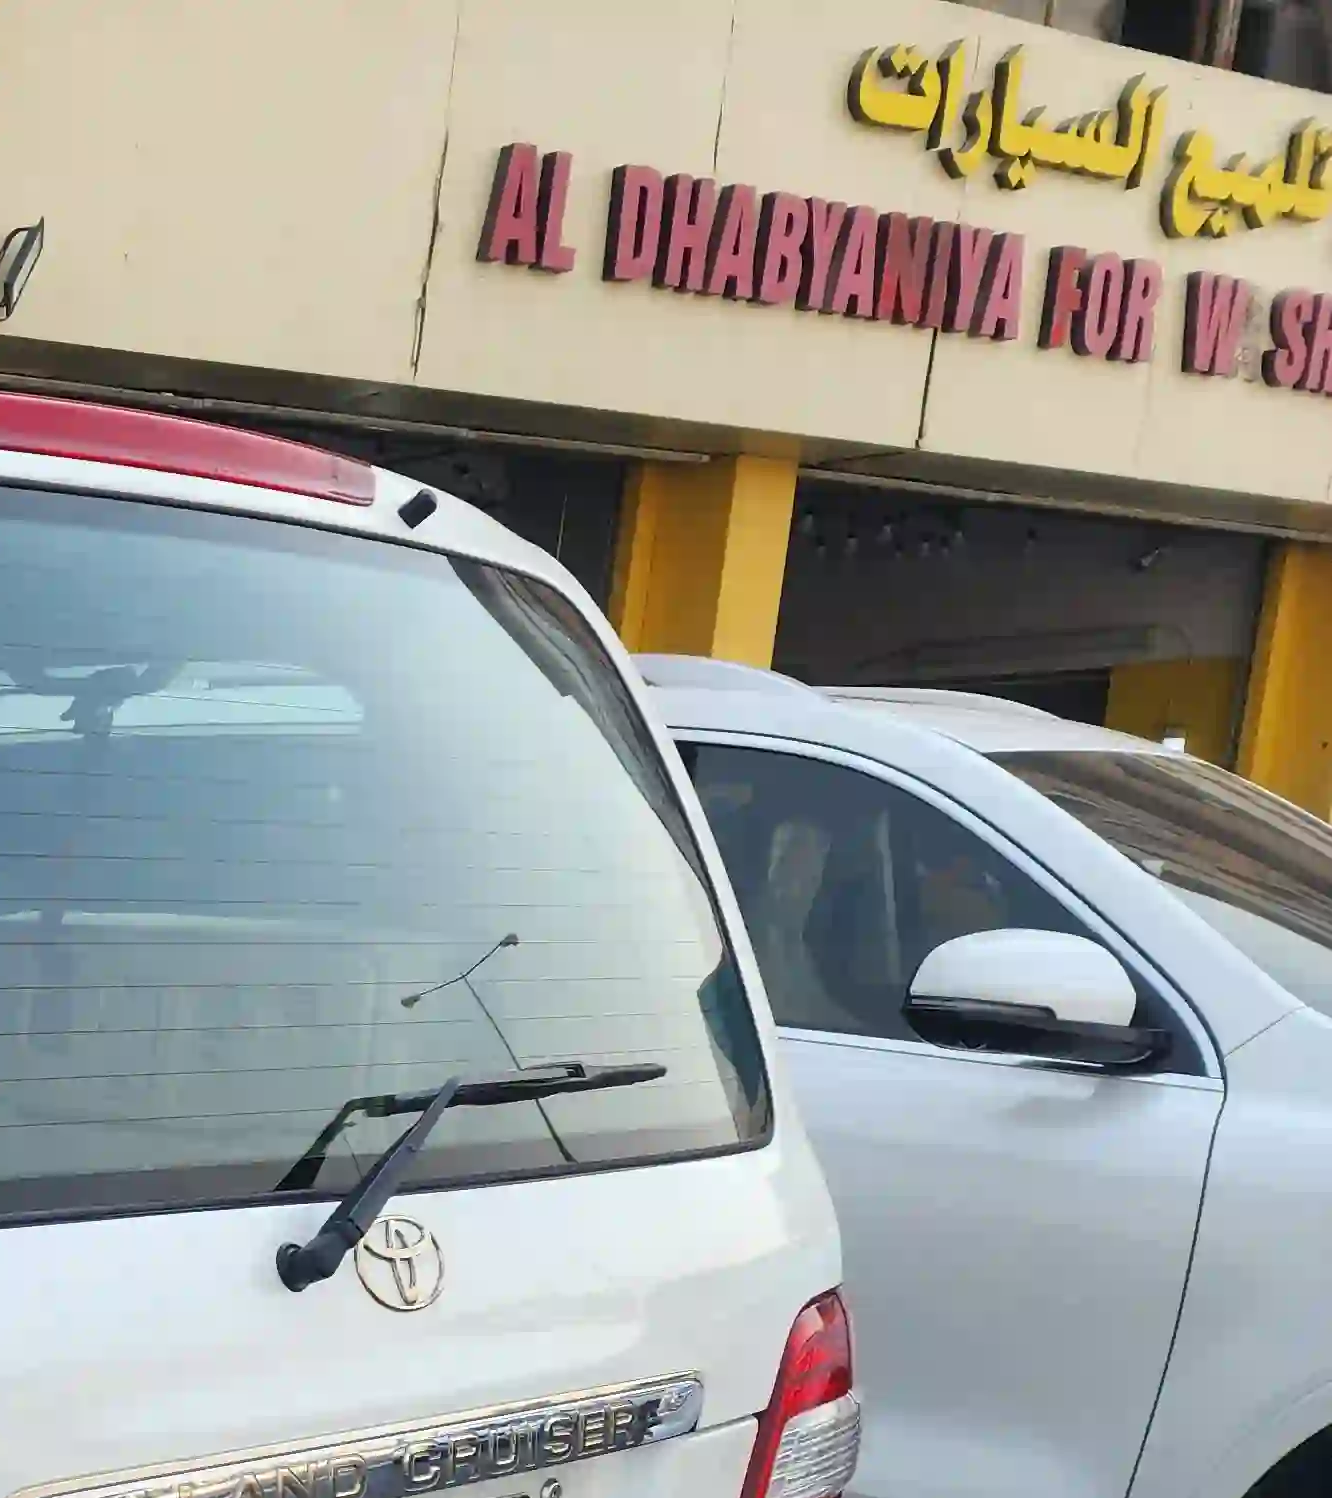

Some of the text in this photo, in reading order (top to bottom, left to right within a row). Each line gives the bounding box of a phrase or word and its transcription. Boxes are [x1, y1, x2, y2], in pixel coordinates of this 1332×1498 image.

[847, 38, 1169, 191] السيارات
[476, 142, 1332, 397] AL DHABYANIYA FOR WSH
[401, 1400, 646, 1493] CRUISER
